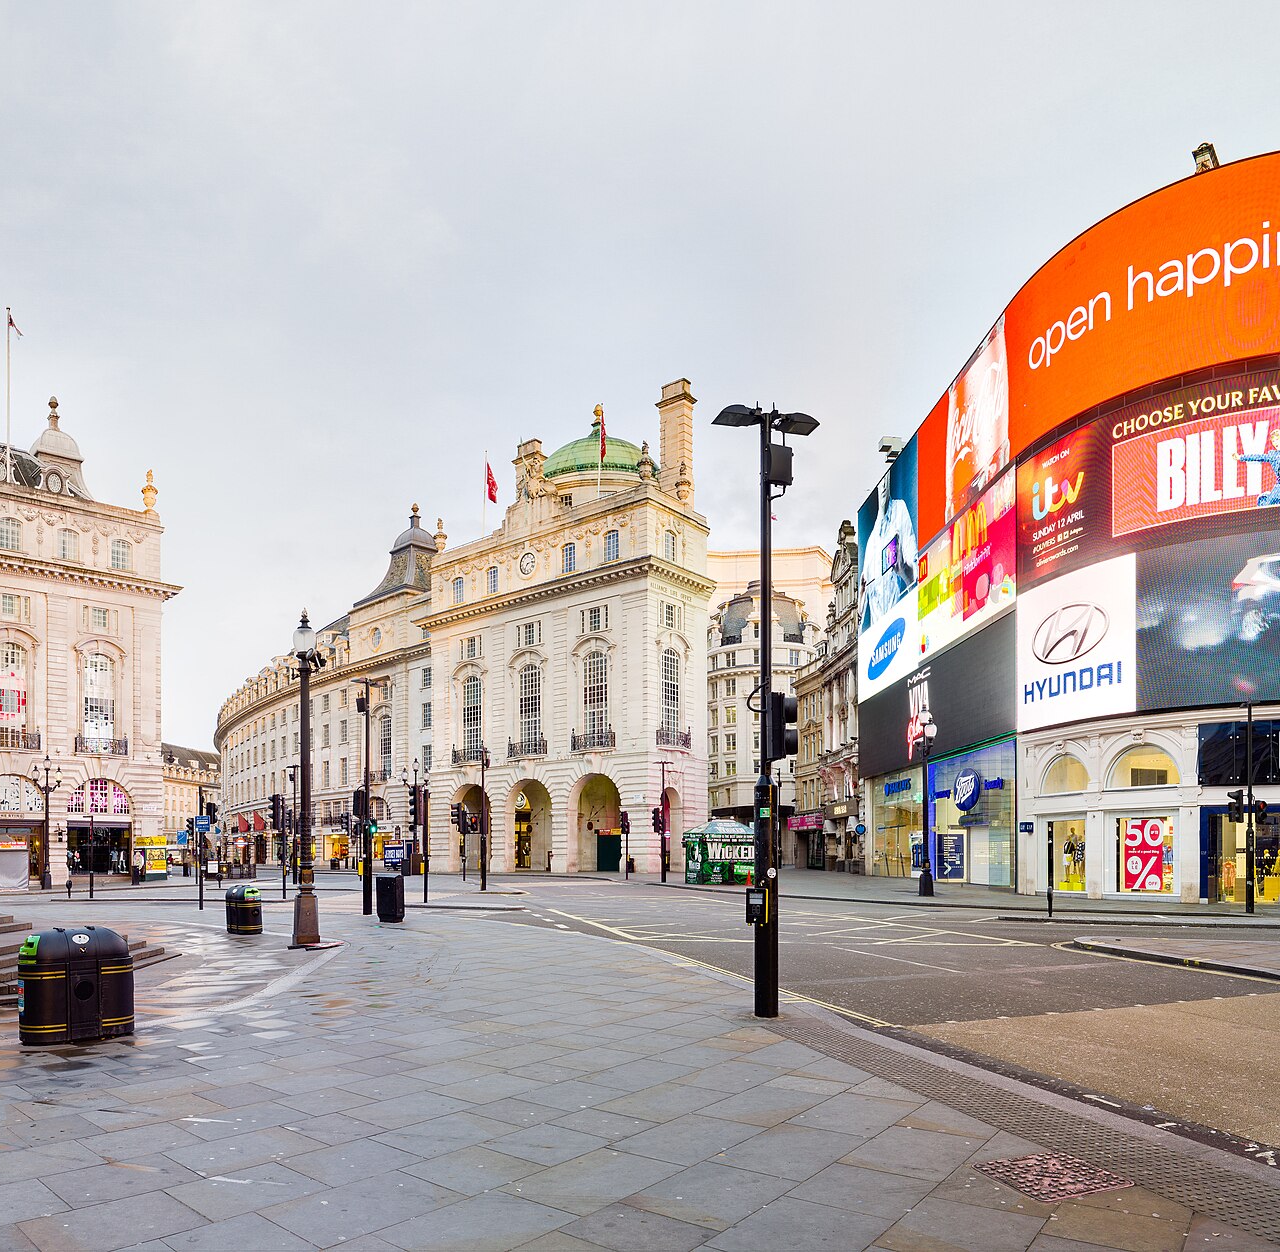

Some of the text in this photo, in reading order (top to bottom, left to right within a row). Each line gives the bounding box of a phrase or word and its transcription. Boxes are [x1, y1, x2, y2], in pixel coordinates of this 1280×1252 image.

[1028, 290, 1112, 370] open
[1112, 404, 1184, 439] CHOOSE
[1188, 391, 1243, 416] YOUR
[1042, 448, 1070, 469] WATCH ON
[1156, 420, 1270, 512] BILLY
[1032, 471, 1084, 520] itv
[1032, 521, 1056, 542] SUNDAY
[1057, 518, 1066, 529] 12
[1066, 510, 1085, 526] APRIL
[871, 631, 902, 667] SAMSUNG
[909, 681, 930, 717] VIVA
[1024, 661, 1122, 705] HYUNDAI
[706, 841, 754, 860] WICKED
[1125, 819, 1165, 847] 50
